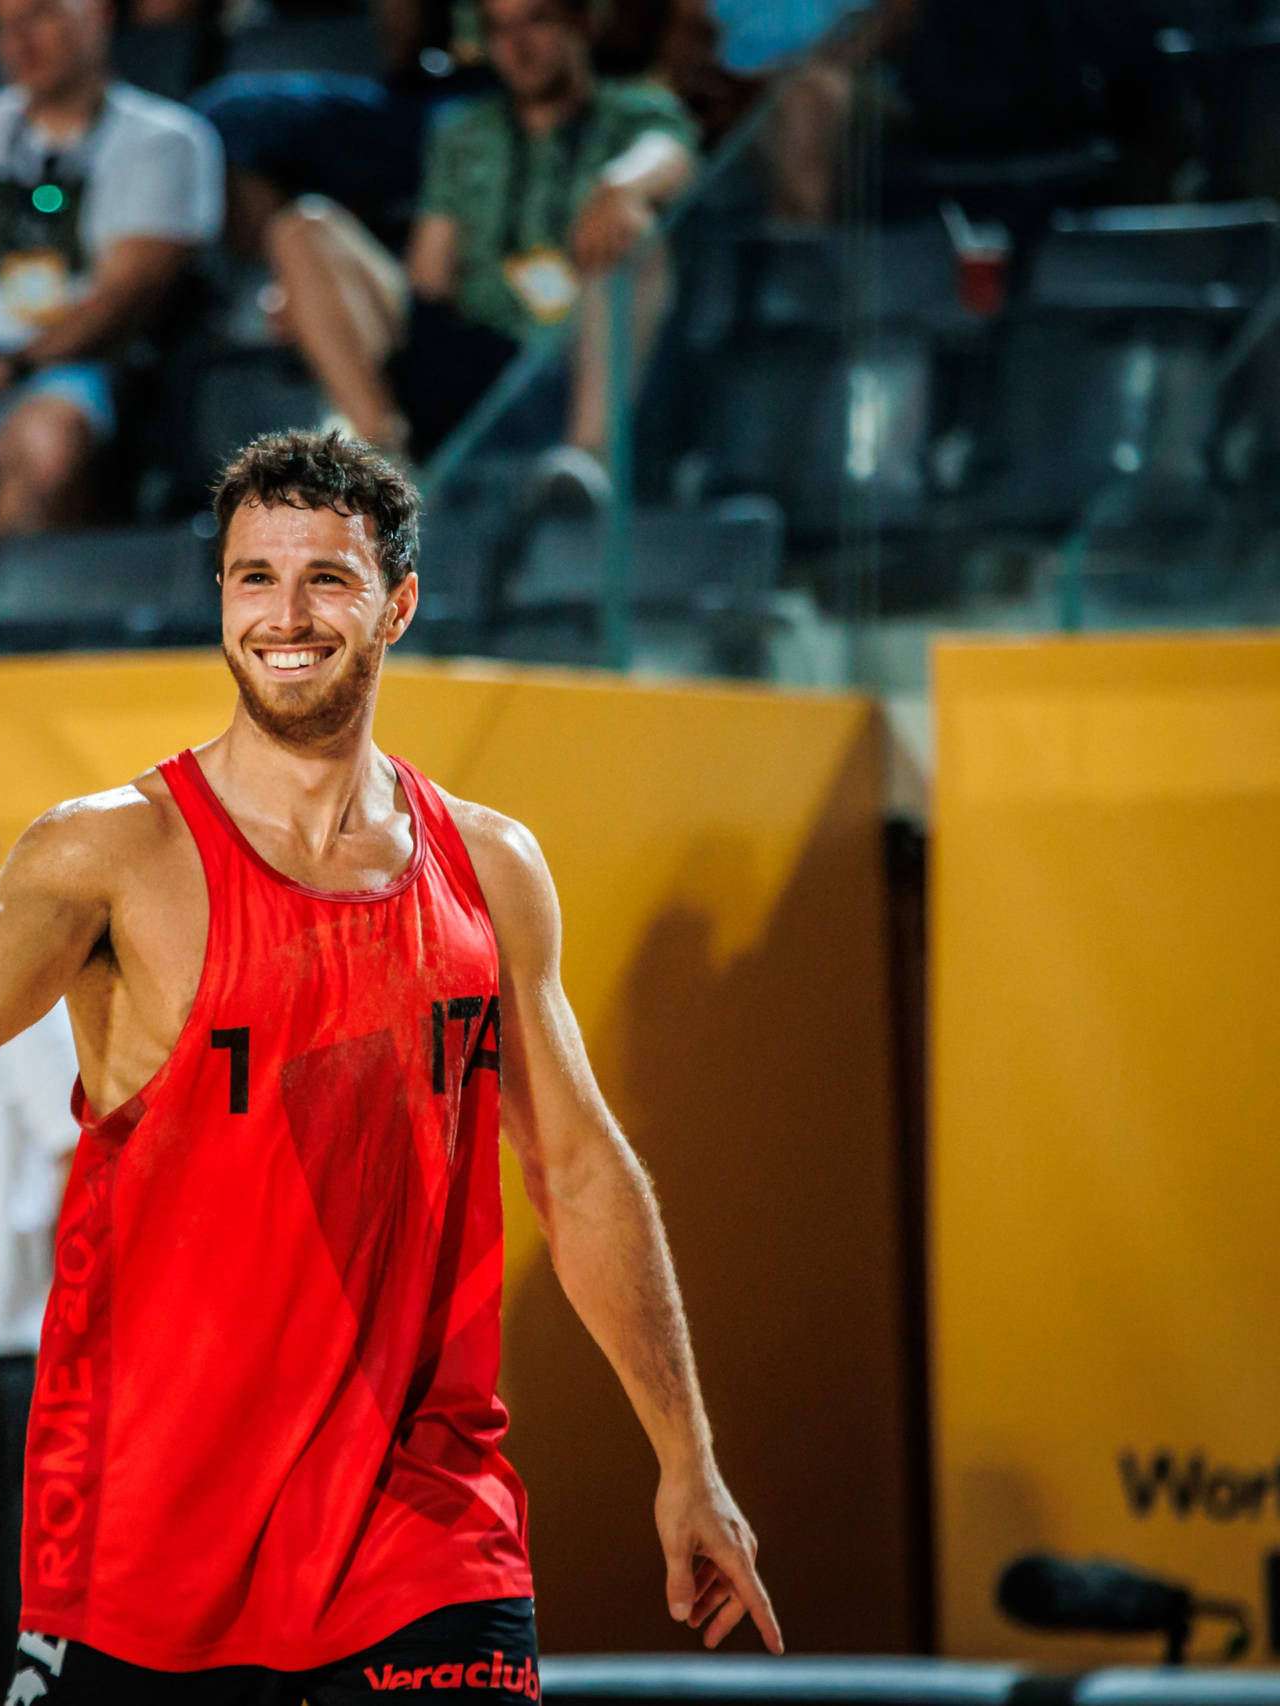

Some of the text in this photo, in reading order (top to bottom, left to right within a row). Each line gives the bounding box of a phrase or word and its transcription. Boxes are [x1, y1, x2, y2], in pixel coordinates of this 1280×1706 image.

[211, 1026, 250, 1115] 1
[431, 995, 501, 1095] ITA
[36, 1356, 94, 1589] ROME
[1117, 1447, 1280, 1522] Wor
[363, 1650, 541, 1701] Veraclub
